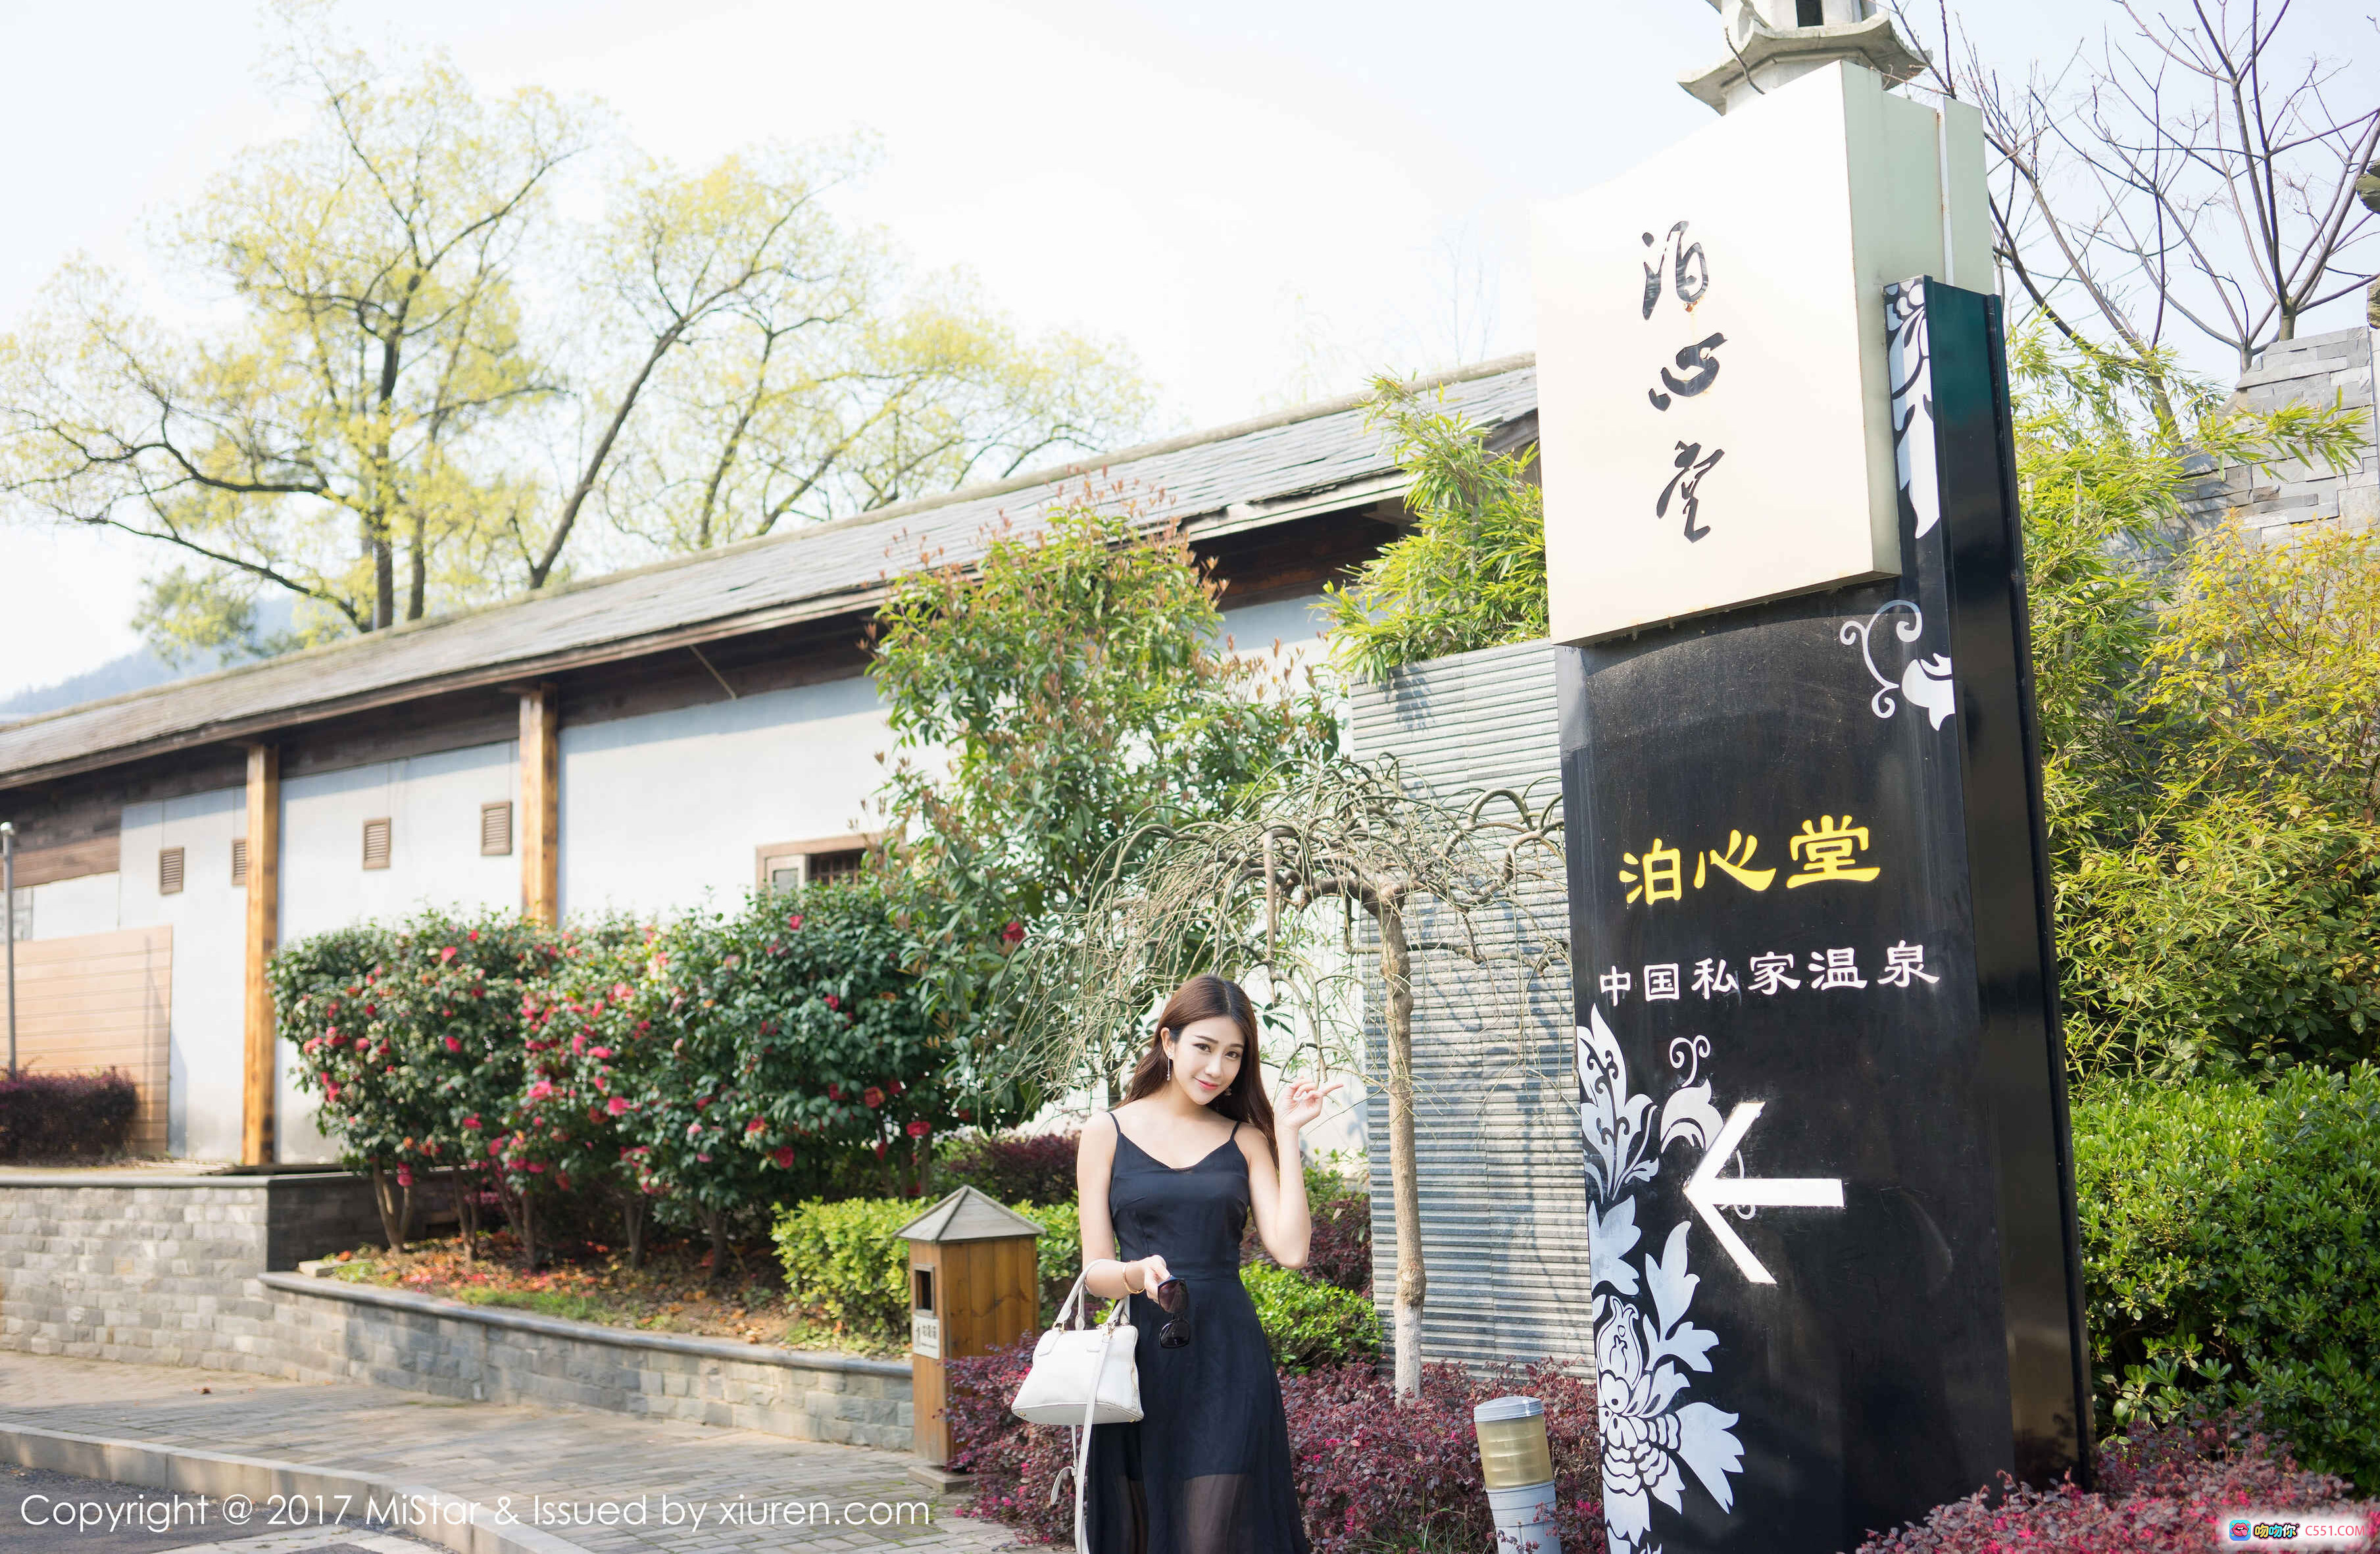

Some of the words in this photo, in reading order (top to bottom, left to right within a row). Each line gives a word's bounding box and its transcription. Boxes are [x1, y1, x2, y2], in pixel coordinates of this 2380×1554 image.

[1641, 220, 1728, 544] 泊心堂
[1618, 814, 1881, 906] 泊心堂
[1599, 940, 1941, 1007] 中国私家温泉
